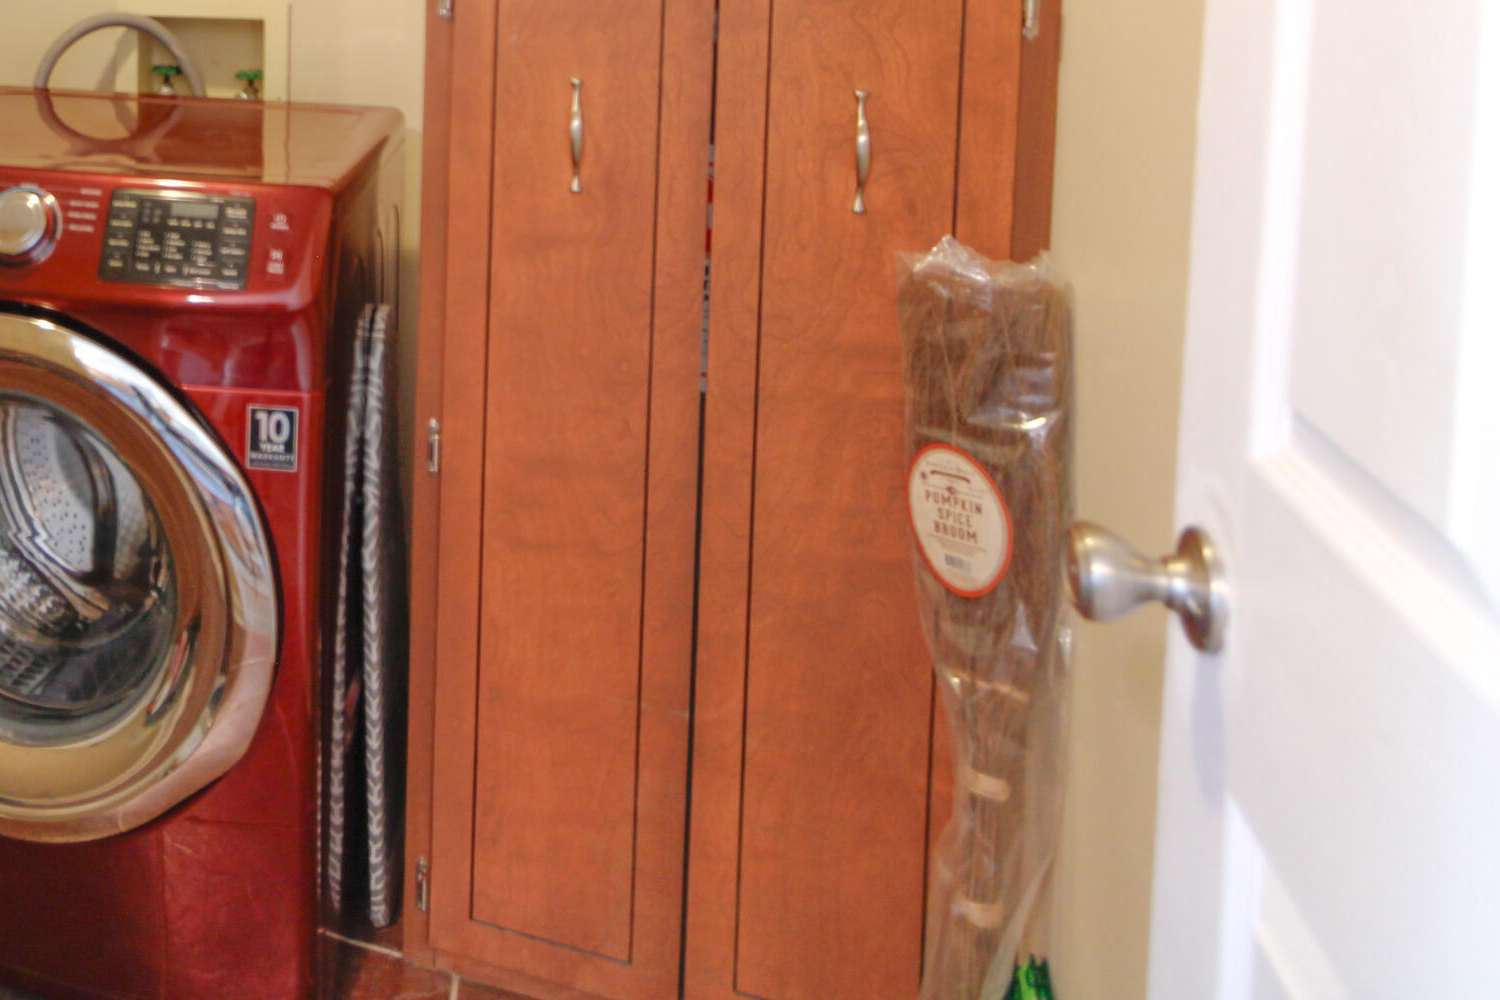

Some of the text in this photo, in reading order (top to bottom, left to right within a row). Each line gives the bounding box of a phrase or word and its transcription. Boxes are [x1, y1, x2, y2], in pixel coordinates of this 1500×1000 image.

[254, 410, 291, 443] 10
[925, 489, 983, 515] PUMPKIN
[937, 507, 973, 528] SPICE
[934, 520, 979, 544] BROOM
